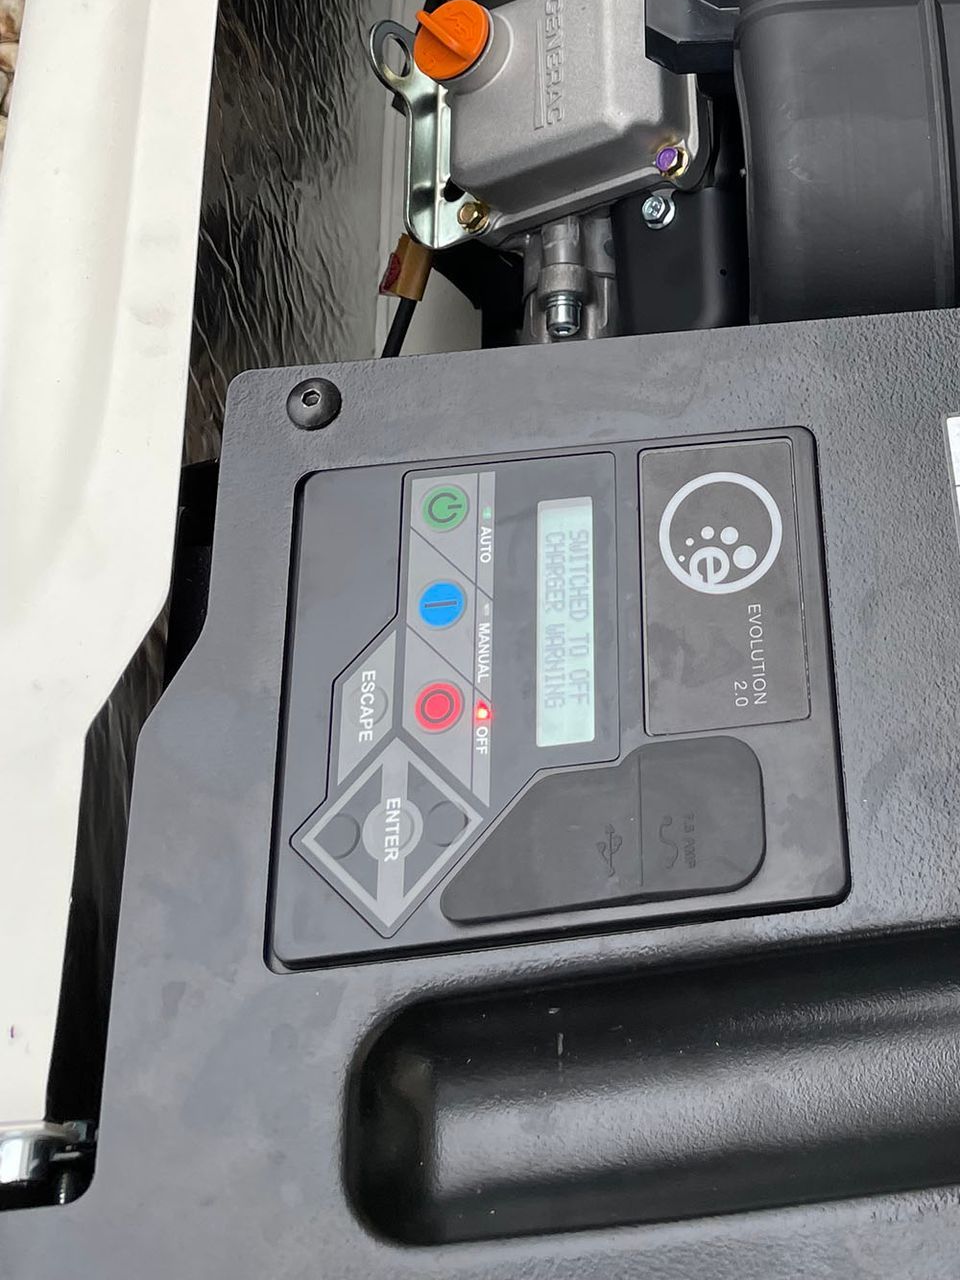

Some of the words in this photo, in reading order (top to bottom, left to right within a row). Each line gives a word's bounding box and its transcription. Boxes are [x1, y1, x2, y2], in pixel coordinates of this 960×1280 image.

[479, 527, 492, 563] AUTO
[545, 531, 566, 613] CHARGER
[569, 529, 590, 621] SWITCHED
[477, 623, 491, 683] MANUAL
[544, 623, 566, 709] WARNING
[569, 632, 590, 657] TO
[748, 604, 767, 705] EVOLUTION
[358, 670, 376, 742] ESCAPE
[569, 669, 591, 706] OFF
[734, 680, 749, 707] 2.0
[475, 726, 488, 755] OFF
[384, 797, 401, 863] ENTER
